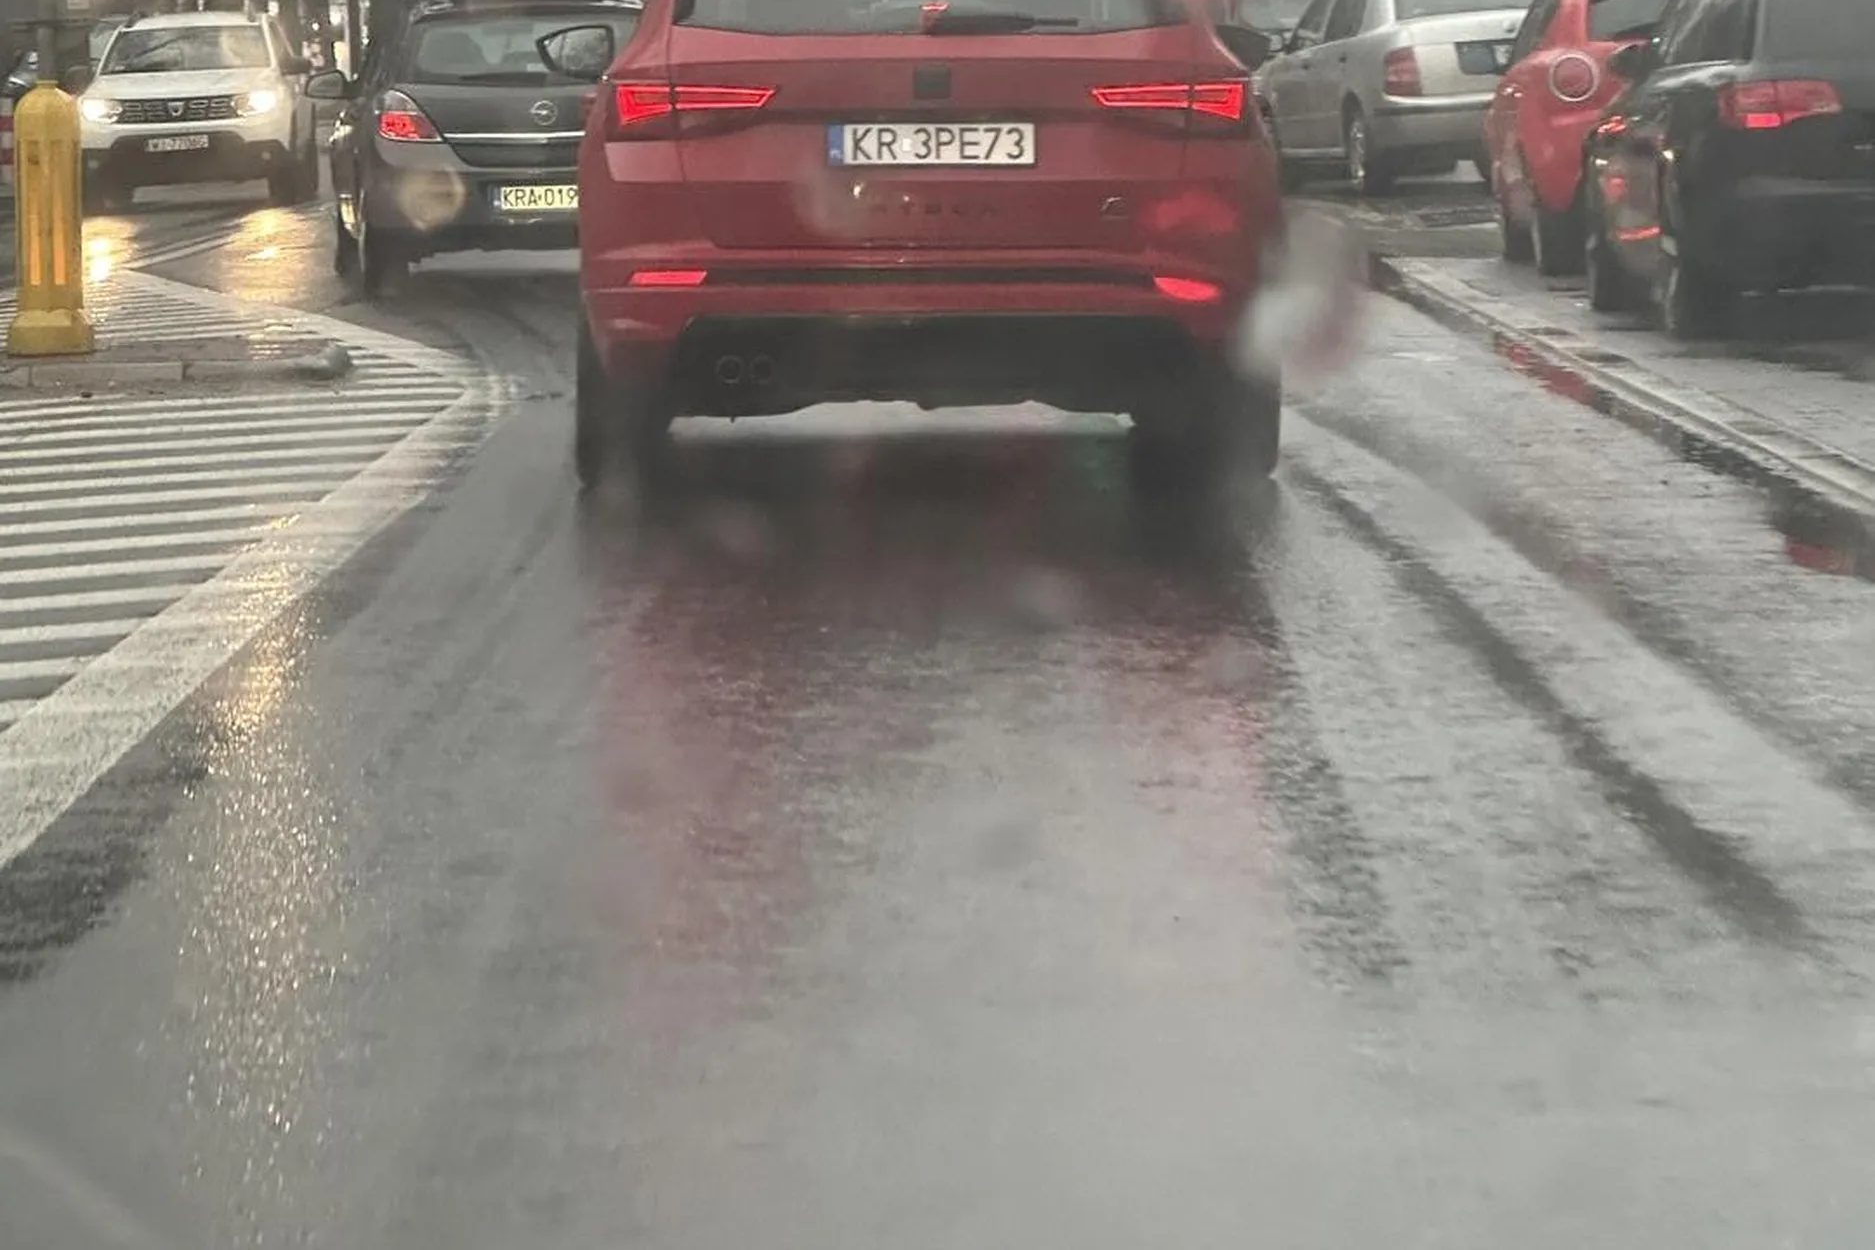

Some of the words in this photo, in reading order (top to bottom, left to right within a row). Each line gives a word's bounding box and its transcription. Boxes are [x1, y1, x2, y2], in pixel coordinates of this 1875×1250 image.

[852, 127, 898, 161] KR
[913, 127, 1025, 160] 3PE73
[503, 188, 538, 207] KRA
[544, 187, 578, 206] 019
